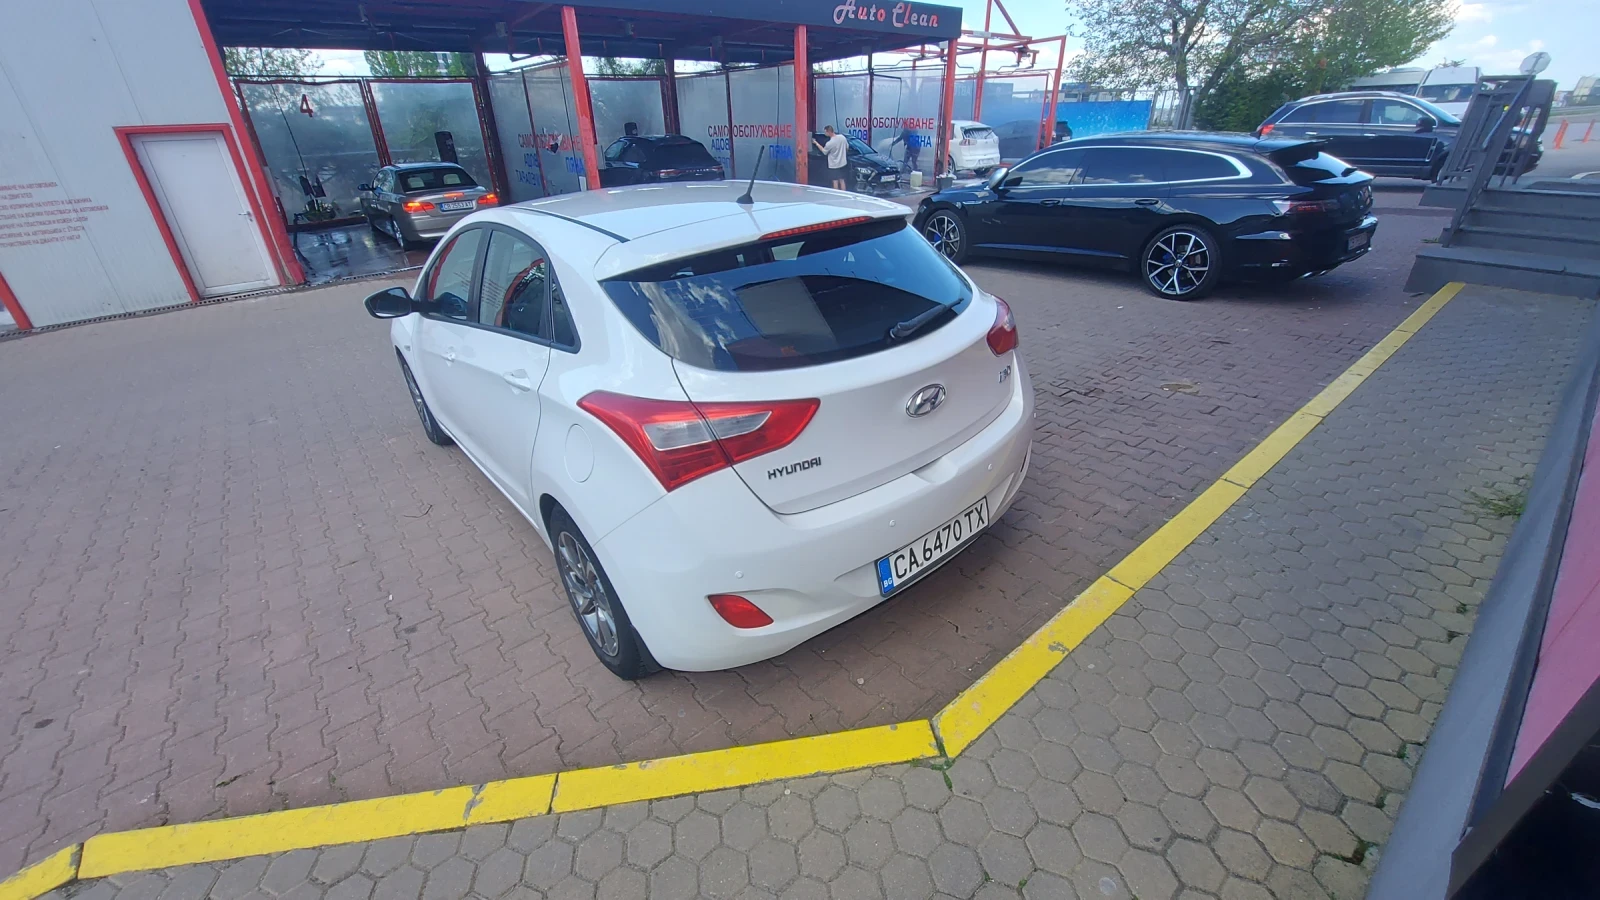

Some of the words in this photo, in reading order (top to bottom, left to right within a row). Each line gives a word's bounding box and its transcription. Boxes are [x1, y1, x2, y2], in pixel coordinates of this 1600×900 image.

[833, 0, 886, 25] Auto
[892, 2, 939, 28] Clean
[300, 93, 314, 118] 4
[767, 456, 822, 480] HYUNDAI
[893, 547, 920, 579] CA
[922, 519, 962, 562] 6470
[963, 503, 985, 533] TX
[883, 577, 893, 588] BG
